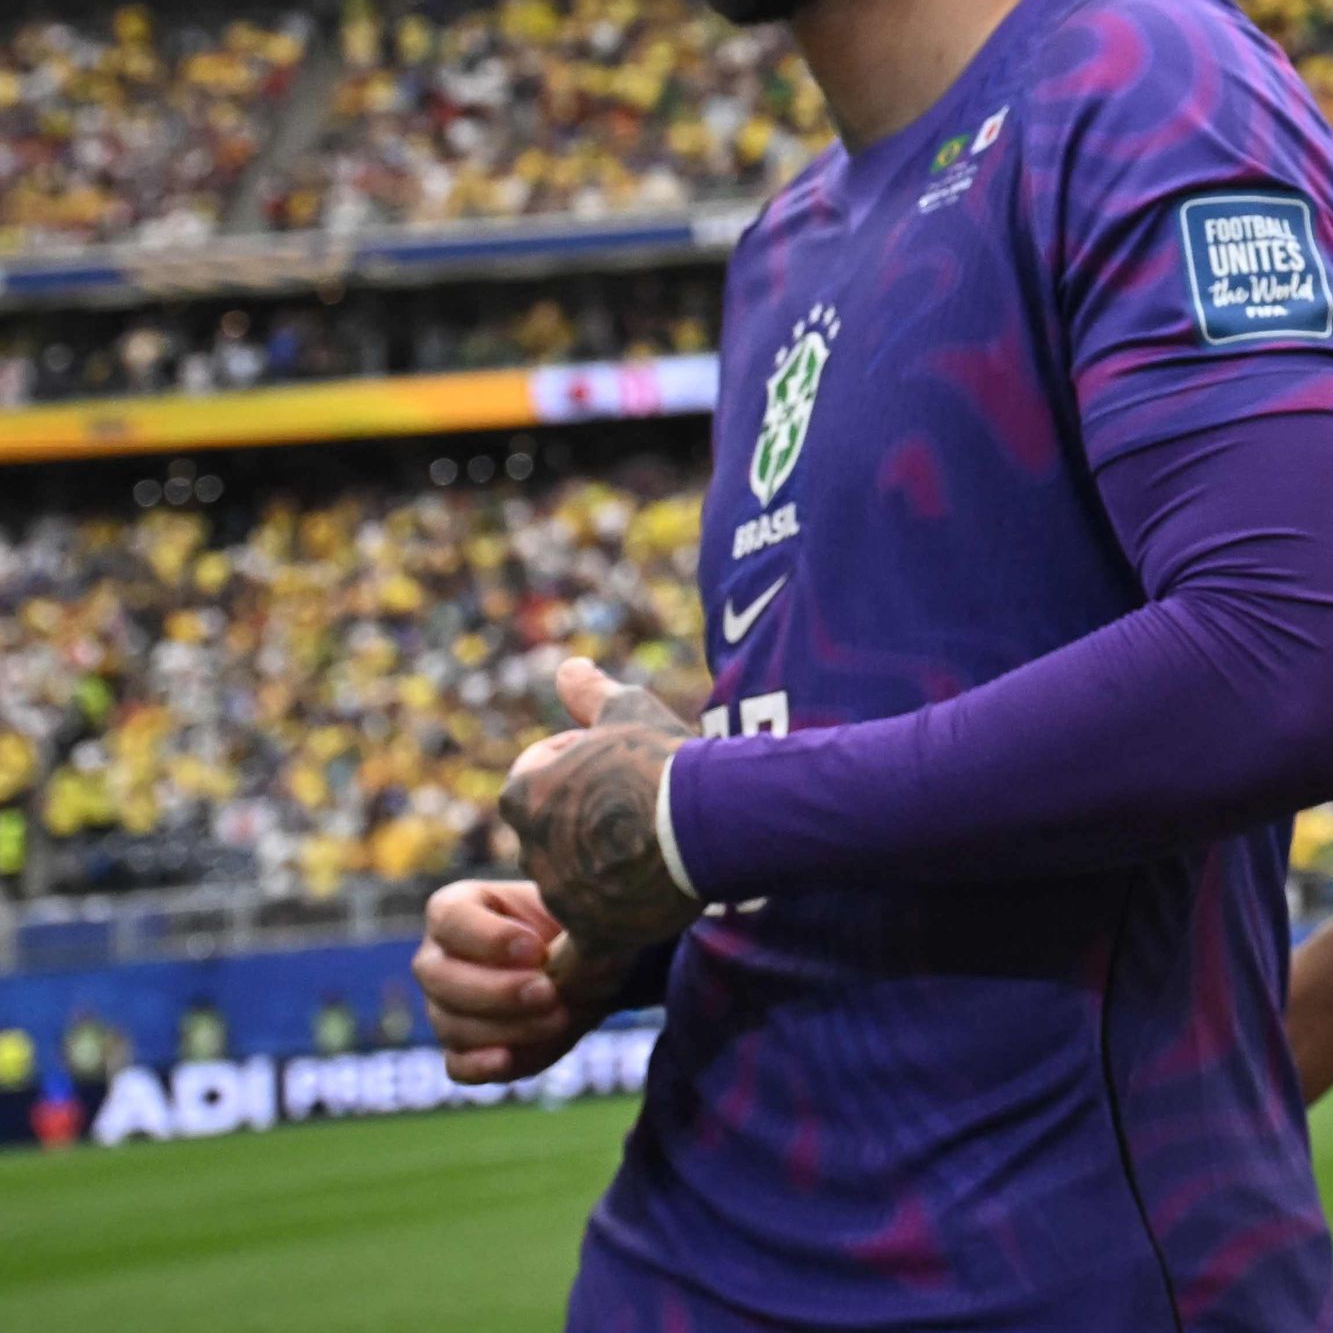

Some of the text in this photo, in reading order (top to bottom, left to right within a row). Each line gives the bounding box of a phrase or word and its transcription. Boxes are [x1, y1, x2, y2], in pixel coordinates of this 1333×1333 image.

[1204, 215, 1297, 243] FOOTBALL
[1208, 240, 1305, 277] UNITES
[1208, 272, 1315, 308] the World
[732, 501, 800, 560] BRASIL
